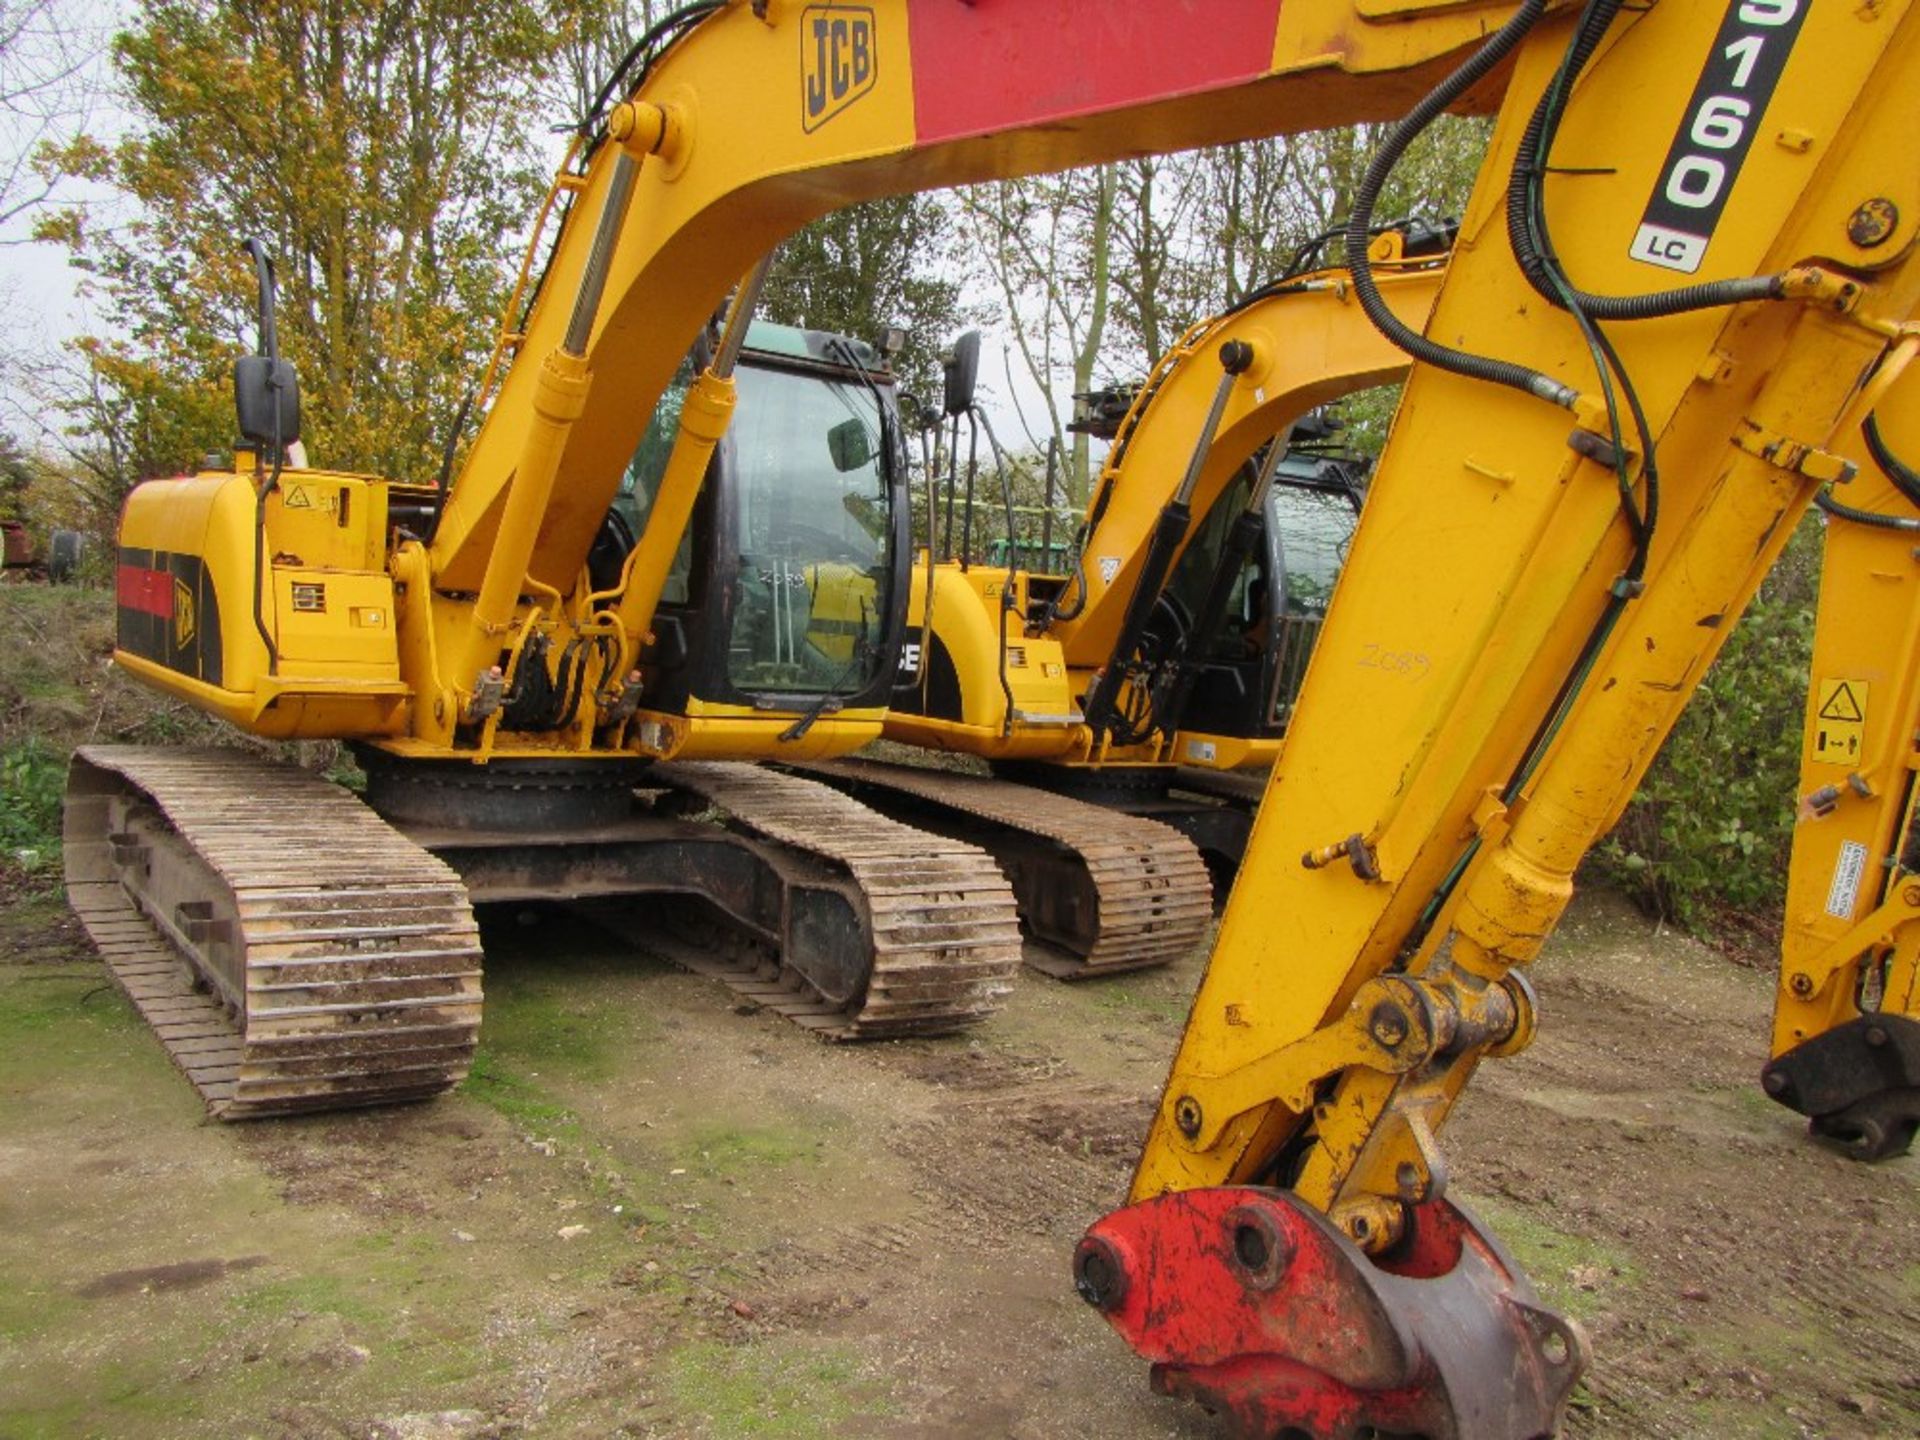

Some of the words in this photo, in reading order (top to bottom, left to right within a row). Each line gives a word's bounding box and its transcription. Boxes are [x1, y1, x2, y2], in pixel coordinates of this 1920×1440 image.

[807, 18, 869, 117] JCB
[1646, 235, 1687, 261] LC
[1356, 643, 1432, 684] 2089
